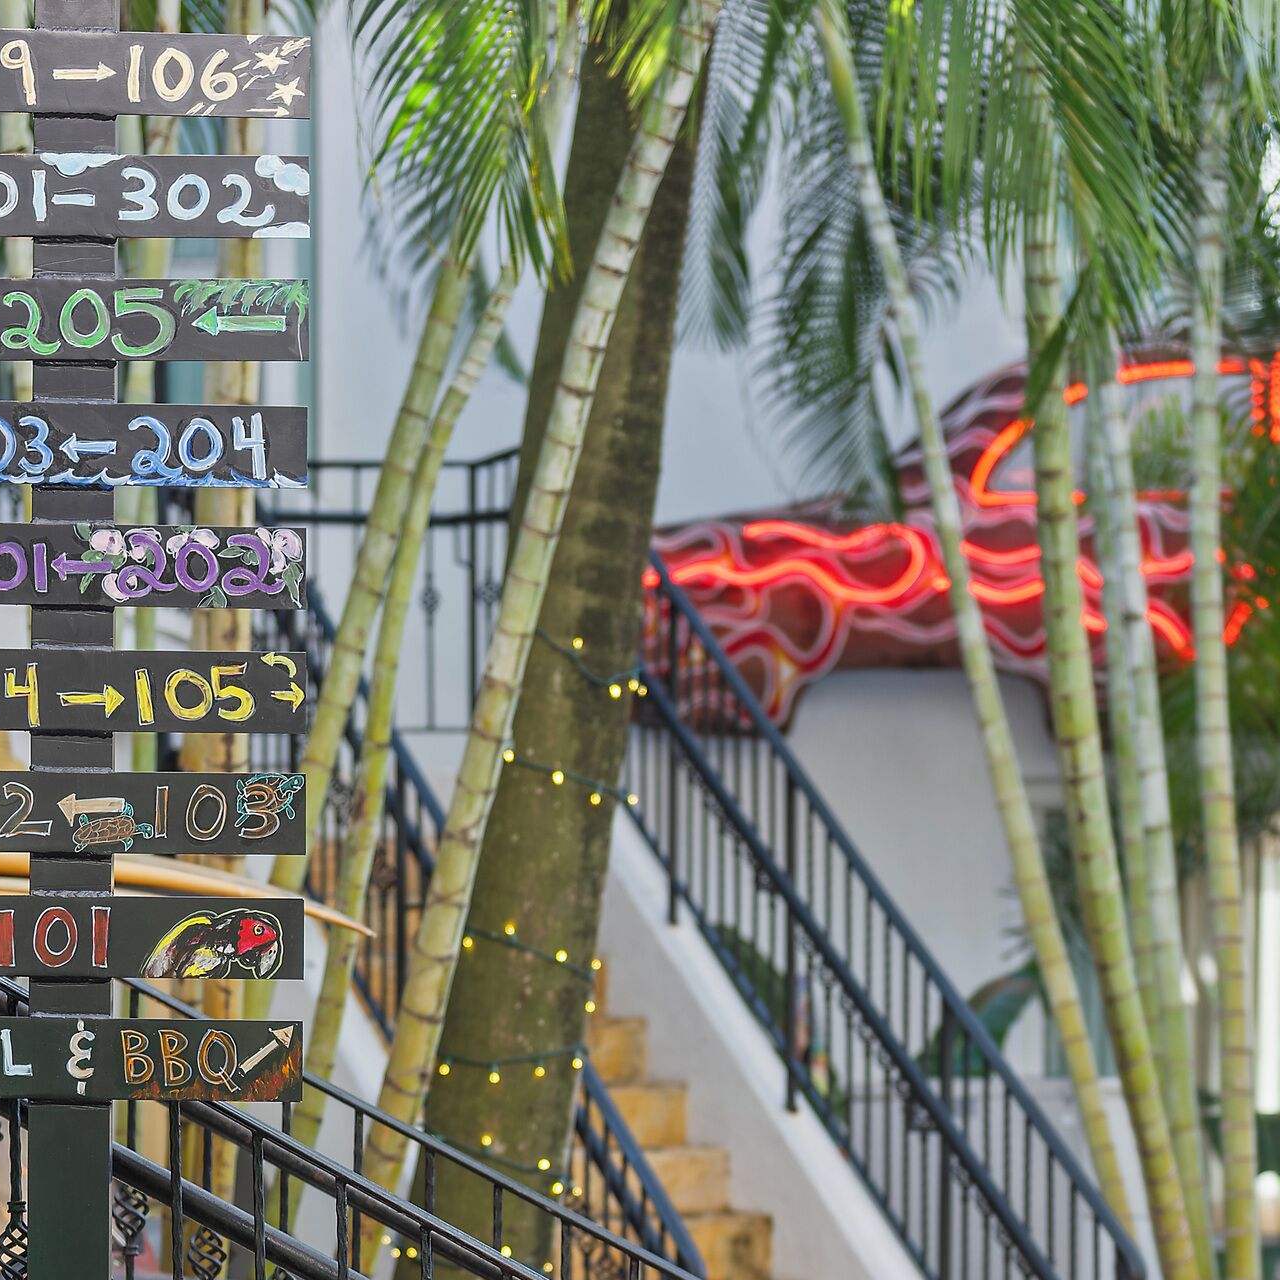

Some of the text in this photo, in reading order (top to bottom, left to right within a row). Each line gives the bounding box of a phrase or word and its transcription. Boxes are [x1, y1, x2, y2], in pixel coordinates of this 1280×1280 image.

[126, 43, 238, 103] 106
[0, 287, 177, 357] 205
[127, 411, 267, 481] 204
[117, 532, 284, 598] 202
[134, 662, 256, 727] 105
[154, 782, 283, 842] 103
[65, 1019, 97, 1096] &
[120, 1028, 242, 1094] BBQ
